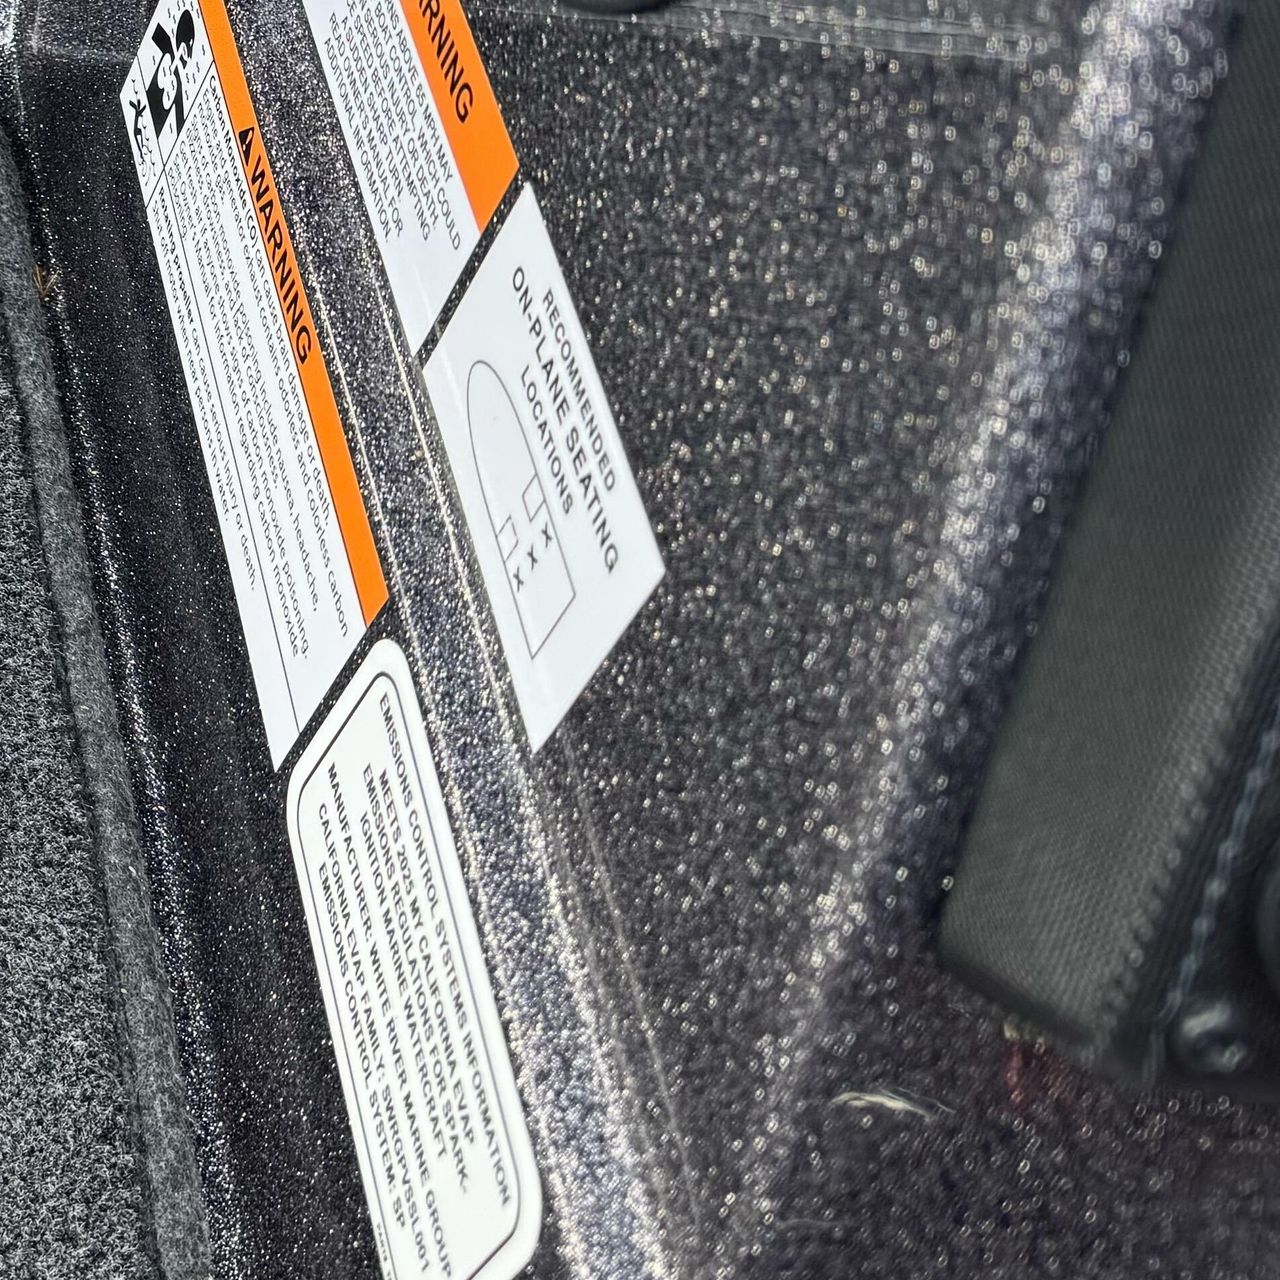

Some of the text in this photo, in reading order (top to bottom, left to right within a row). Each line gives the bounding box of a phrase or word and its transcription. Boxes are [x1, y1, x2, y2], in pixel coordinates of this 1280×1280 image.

[340, 13, 349, 32] A
[344, 25, 370, 95] SUDDEN
[323, 35, 356, 129] ADDITIONAL
[328, 11, 403, 238] READ OWNER'S MANUAL FOR
[353, 13, 374, 70] SPEED
[370, 65, 396, 137] BEFORE
[391, 132, 430, 242] ATTEMPTING
[363, 6, 390, 81] SERIOUS
[386, 75, 410, 139] INJURY
[406, 135, 419, 169] OR
[365, 90, 388, 149] SHARP
[373, 0, 393, 48] BOAT
[416, 124, 440, 190] WHICH
[435, 184, 461, 252] COULD
[395, 25, 419, 87] ABOVE
[414, 81, 426, 109] 65
[421, 102, 440, 148] MPH
[435, 142, 453, 185] MAY
[179, 138, 189, 169] Get
[189, 112, 203, 157] Signs
[197, 99, 218, 174] monoxide
[200, 152, 209, 172] of
[185, 164, 198, 206] fresh
[194, 202, 203, 226] air
[199, 222, 207, 239] if
[204, 169, 221, 225] carbon
[202, 236, 220, 297] anyone
[208, 72, 226, 132] Carbon
[223, 127, 247, 211] Monoxide
[243, 206, 258, 250] (CO)
[254, 246, 265, 279] can
[262, 277, 278, 327] cause
[275, 322, 291, 372] brain
[286, 369, 310, 446] damage
[306, 443, 315, 466] or
[218, 221, 241, 303] monoxide
[249, 153, 312, 367] WARNING
[152, 198, 163, 236] Shut
[160, 233, 169, 259] off
[165, 256, 179, 304] motor
[176, 302, 190, 349] when
[186, 347, 198, 385] near
[194, 384, 213, 451] persons
[210, 446, 218, 468] in
[157, 184, 176, 256] Rotating
[172, 251, 194, 328] propeller
[191, 326, 201, 357] can
[198, 355, 212, 404] cause
[209, 401, 227, 462] serious
[222, 458, 239, 513] injury
[235, 511, 243, 532] or
[201, 87, 348, 638] Engine and generator exhaust contains odorless and colorless carbon
[217, 293, 233, 347] shows
[223, 278, 235, 312] and
[231, 308, 244, 347] lack
[240, 343, 249, 365] of
[228, 343, 244, 391] signs
[236, 299, 262, 386] poisoning
[172, 151, 182, 183] See
[179, 178, 197, 242] Owner's
[193, 237, 212, 299] Manual
[207, 294, 217, 322] for
[236, 414, 261, 502] regarding
[257, 498, 276, 564] carbon
[272, 562, 299, 658] monoxide
[240, 387, 249, 409] of
[258, 380, 278, 448] include
[510, 266, 620, 575] ON-PLANE SEATING
[541, 286, 616, 494] RECOMMENDED
[245, 407, 264, 470] carbon
[520, 362, 574, 516] LOCATIONS
[260, 468, 286, 561] monoxide
[317, 801, 351, 930] CALIFORNIA
[346, 927, 365, 988] EVAP
[359, 989, 386, 1082] FAMILY:
[362, 761, 396, 881] EMISSIONS
[389, 879, 434, 1043] REGULATIONS
[428, 1042, 447, 1098] FOR
[378, 691, 511, 1206] EMISSIONS CONTROL SYSTEMS INFORMATION
[378, 767, 475, 1147] MEETS 2025 MY CALIFORNIA EVAP
[327, 761, 452, 1278] MANUFACTURER: WHITE RIVER MARINE GROUP
[359, 810, 447, 1160] IGNITION MARINE WATERCRAFT
[317, 860, 406, 1231] EMISSIONS CONTROL SYSTEM: SP
